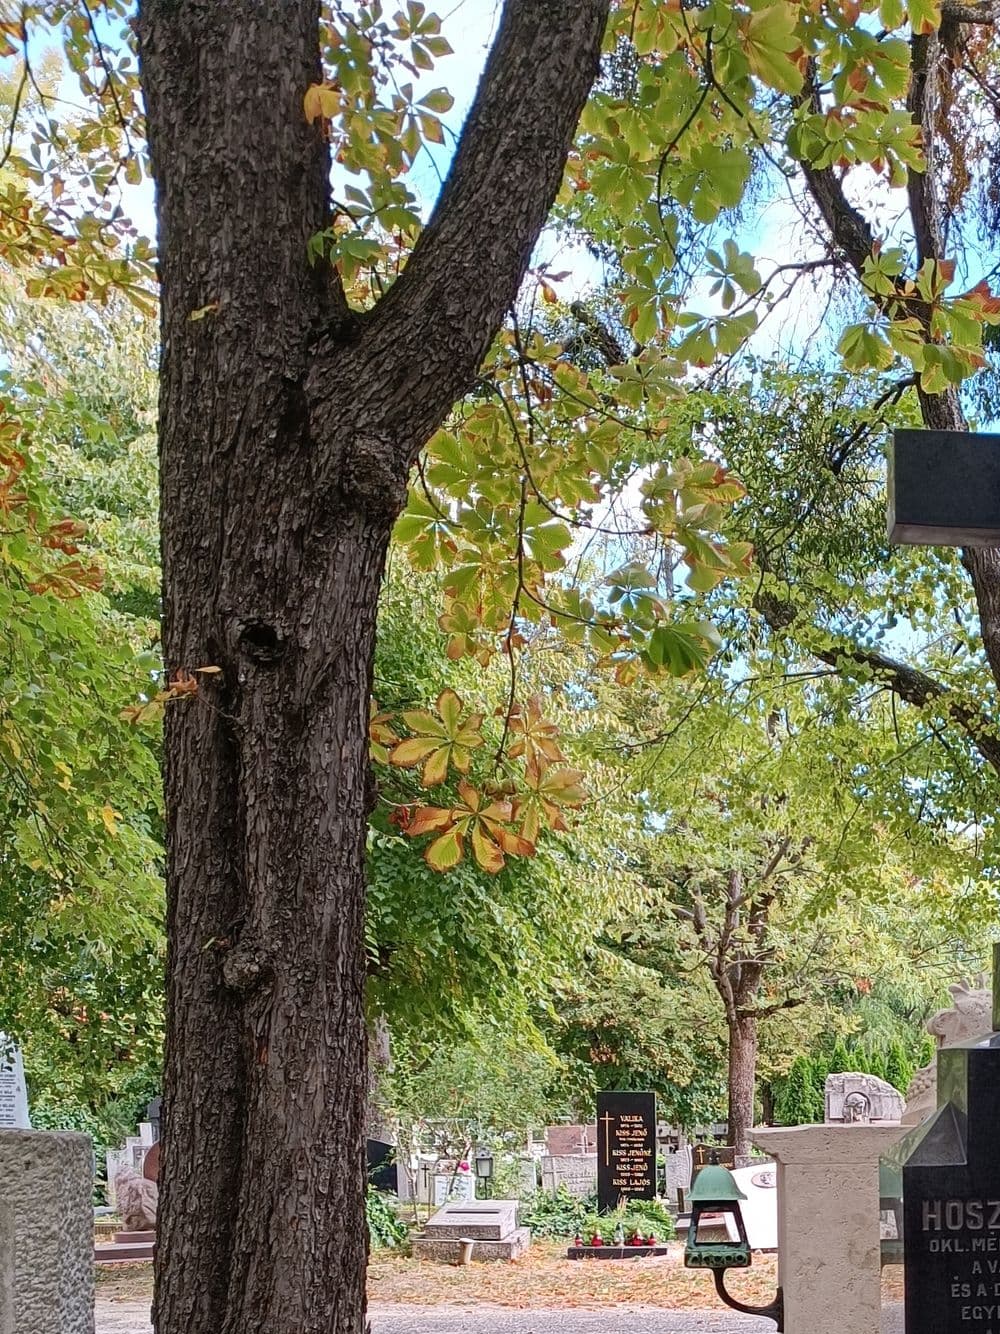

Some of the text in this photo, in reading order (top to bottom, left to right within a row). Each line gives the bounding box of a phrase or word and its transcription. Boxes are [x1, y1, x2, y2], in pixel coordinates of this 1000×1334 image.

[612, 1178, 628, 1186] KISS
[972, 1260, 982, 1274] A
[951, 1276, 971, 1297] ÉS
